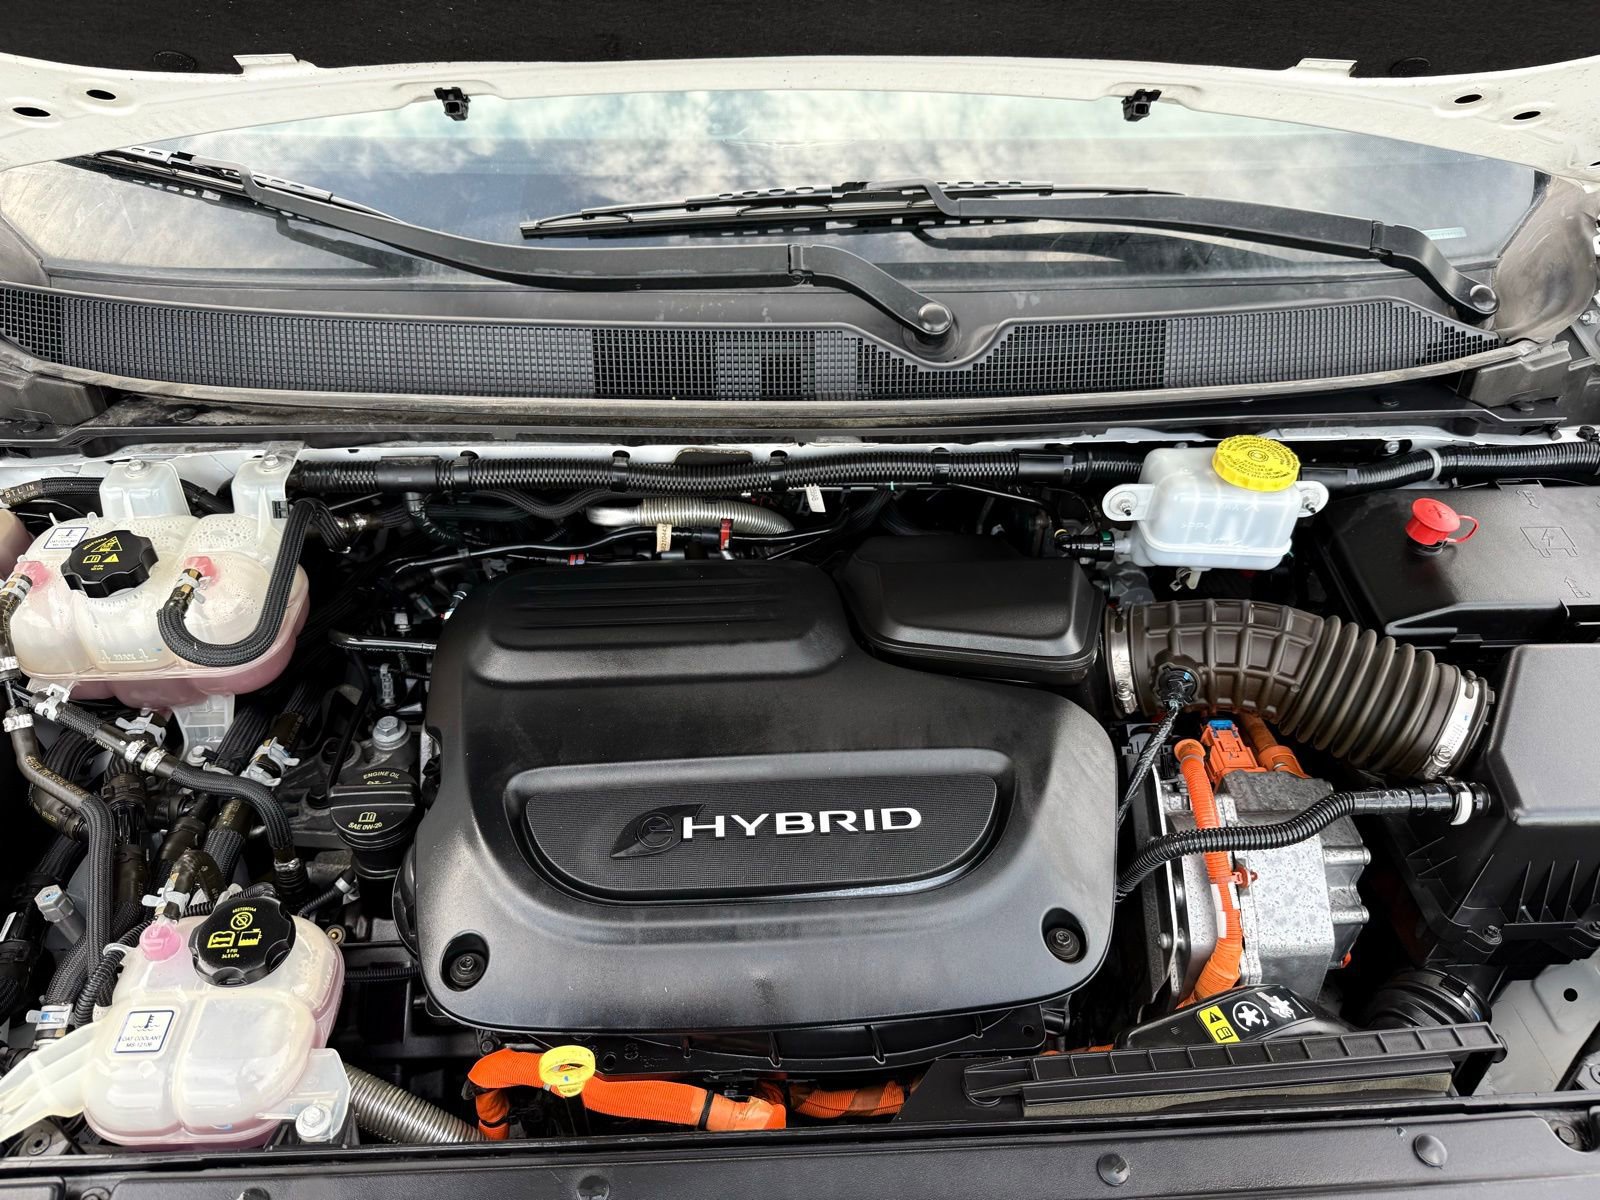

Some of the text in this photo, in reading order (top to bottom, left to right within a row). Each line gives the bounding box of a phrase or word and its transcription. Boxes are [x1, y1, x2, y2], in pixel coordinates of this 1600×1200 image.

[363, 771, 389, 780] ENGINE
[348, 821, 383, 831] SAE 0W-20
[682, 807, 922, 841] HYBRID
